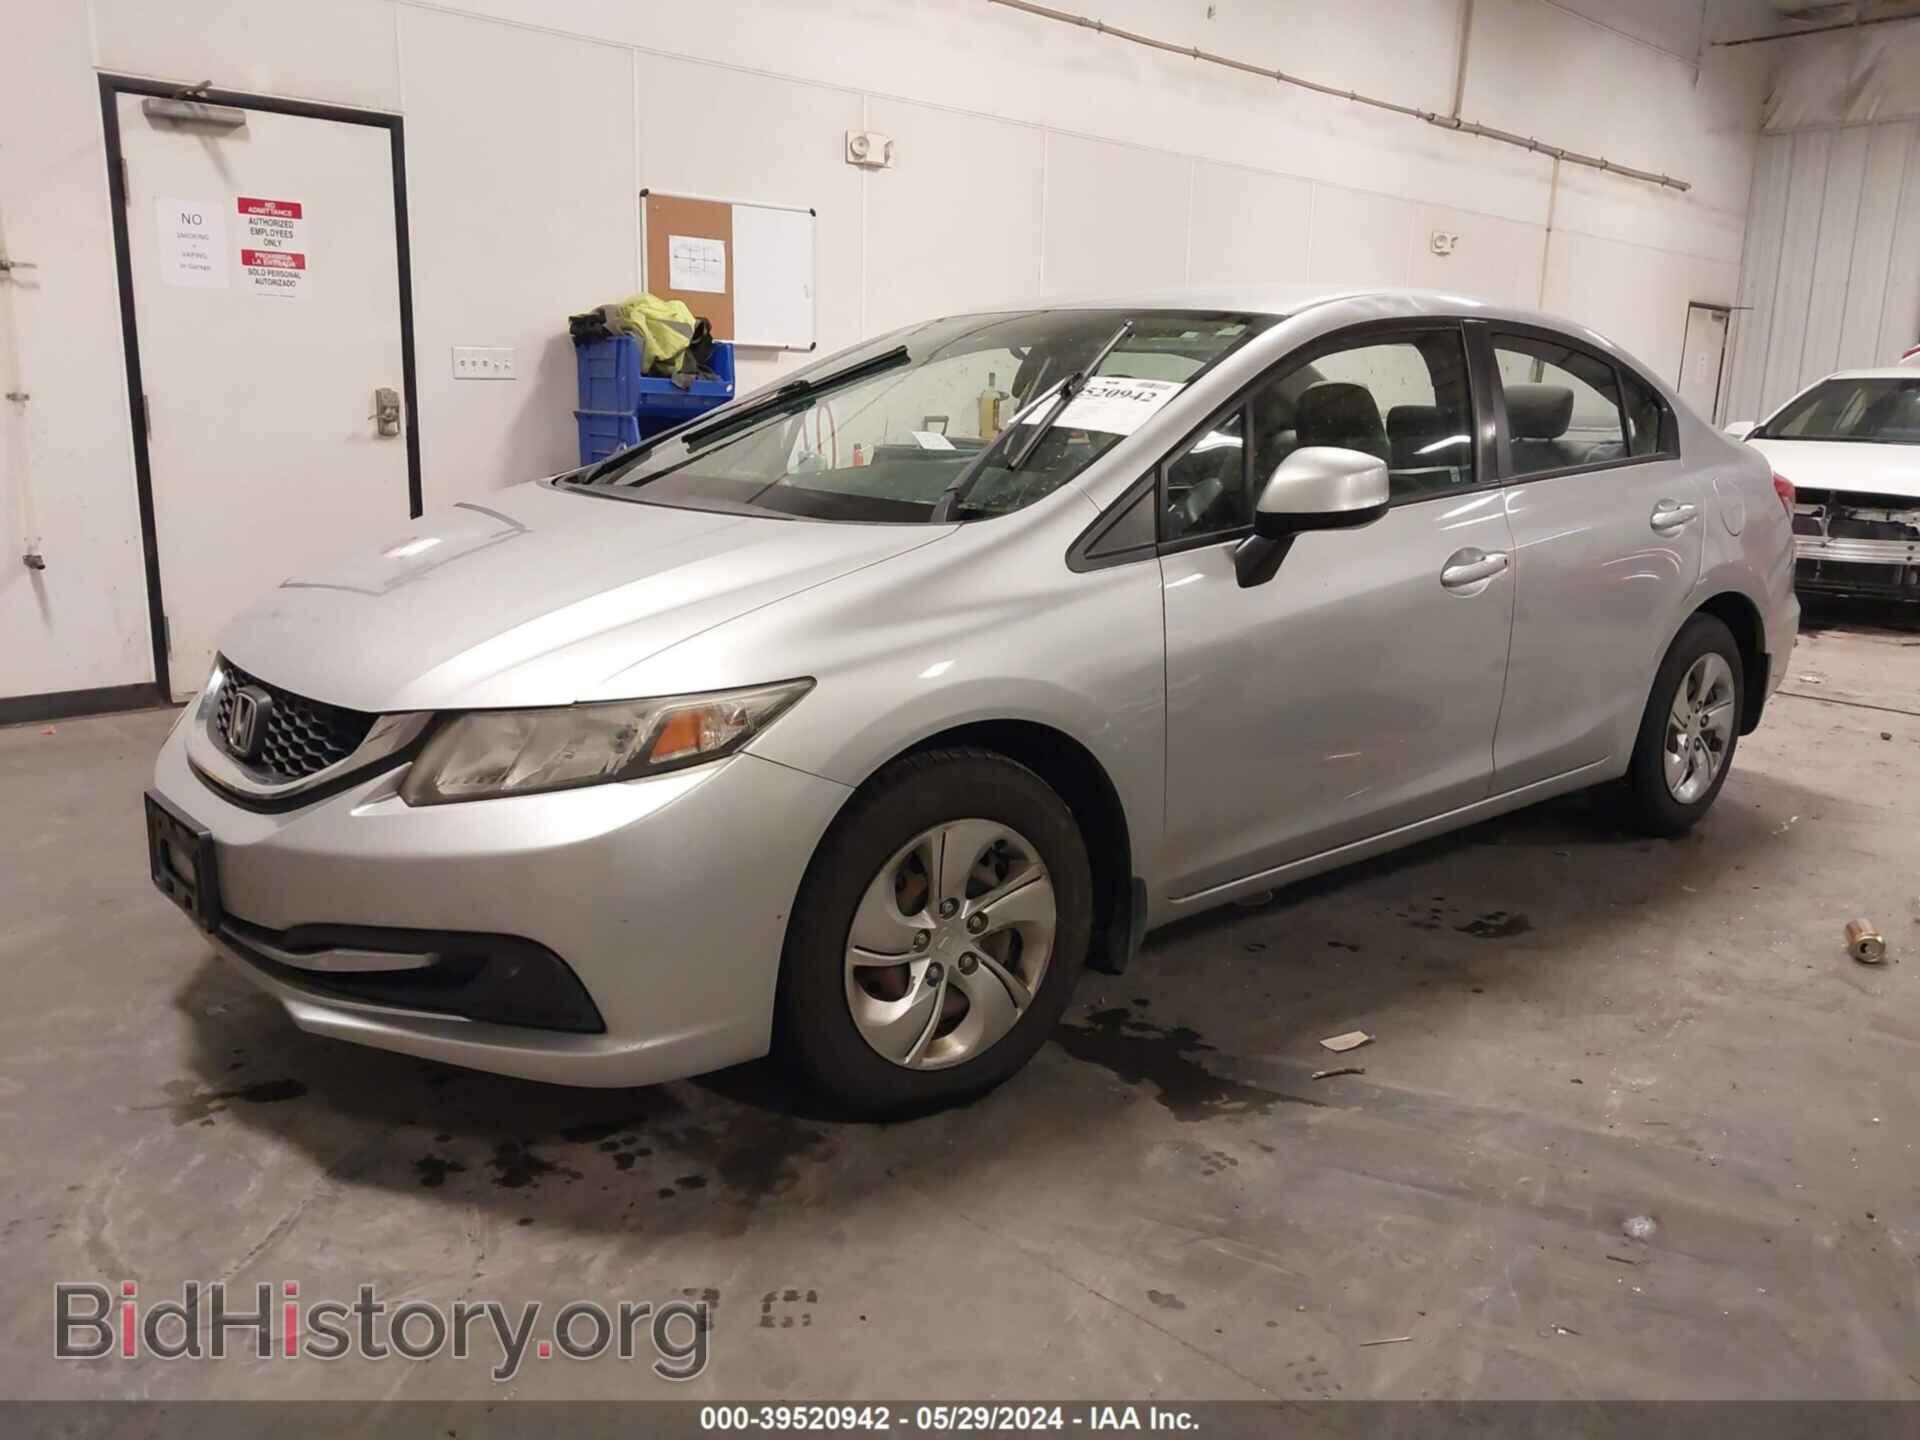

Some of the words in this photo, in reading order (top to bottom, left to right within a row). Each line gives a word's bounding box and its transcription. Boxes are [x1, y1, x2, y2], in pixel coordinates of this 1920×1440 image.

[180, 213, 202, 225] NO
[249, 217, 294, 229] AUTHORIZED
[250, 227, 294, 239] EMPLOYEES
[263, 238, 282, 247] ONLY
[248, 268, 266, 277] SOLO
[267, 269, 301, 279] PERSONAL
[255, 278, 296, 288] AUTORIZADO
[1080, 387, 1157, 402] 520942
